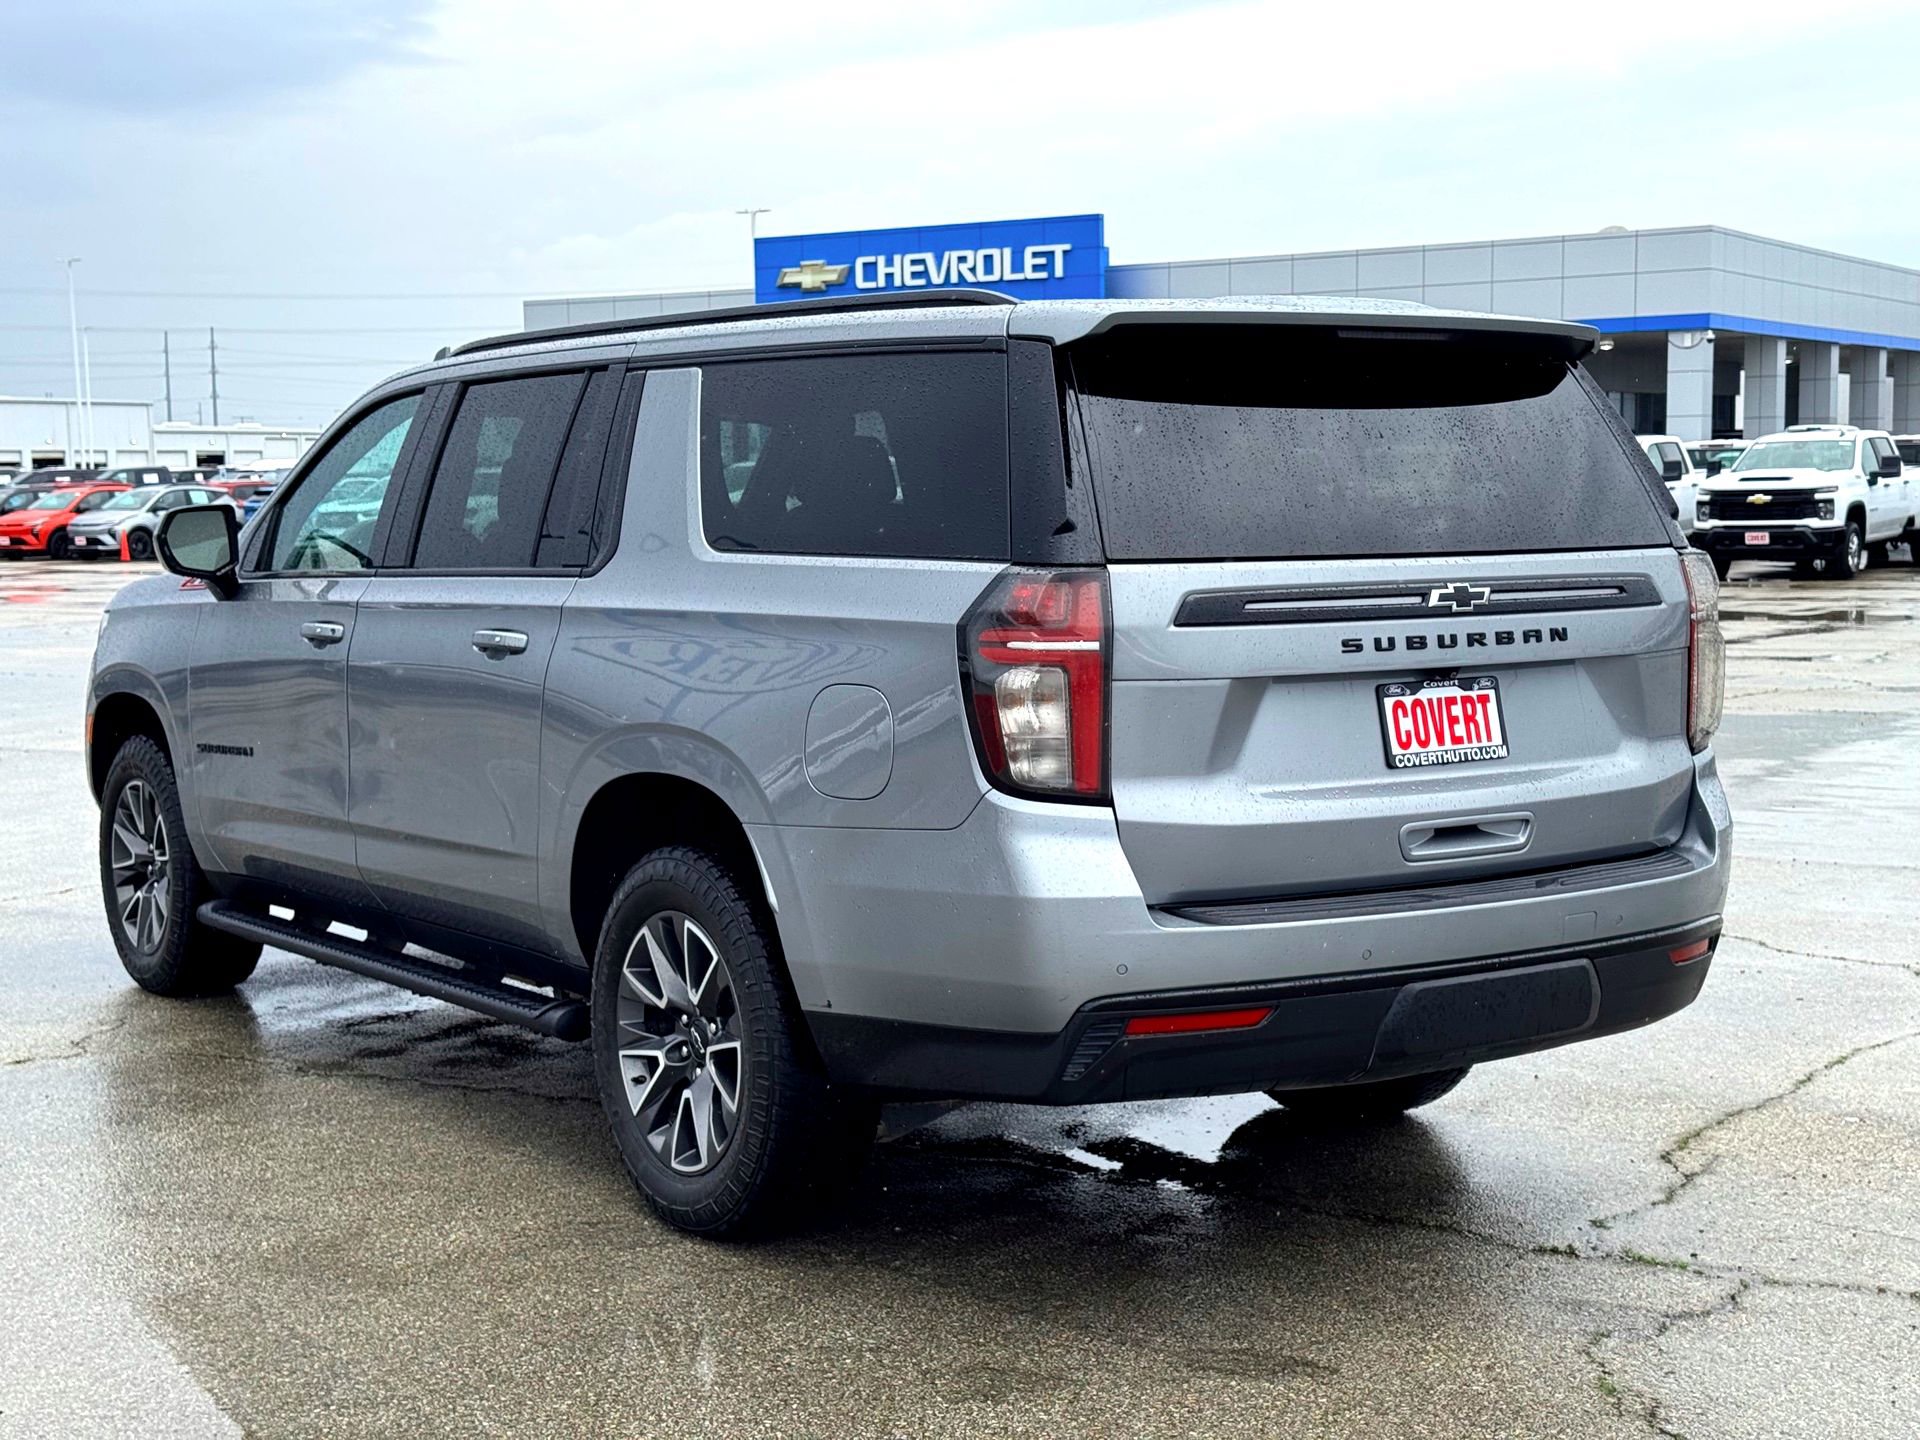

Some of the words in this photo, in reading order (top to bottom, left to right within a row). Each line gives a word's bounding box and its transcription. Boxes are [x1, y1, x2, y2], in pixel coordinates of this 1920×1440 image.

[854, 243, 1072, 290] CHEVROLET
[1341, 627, 1569, 654] SUBURBAN
[1423, 679, 1460, 688] Covert
[1392, 694, 1493, 751] COVERT
[1395, 745, 1508, 768] COVERTHUTTO.COM
